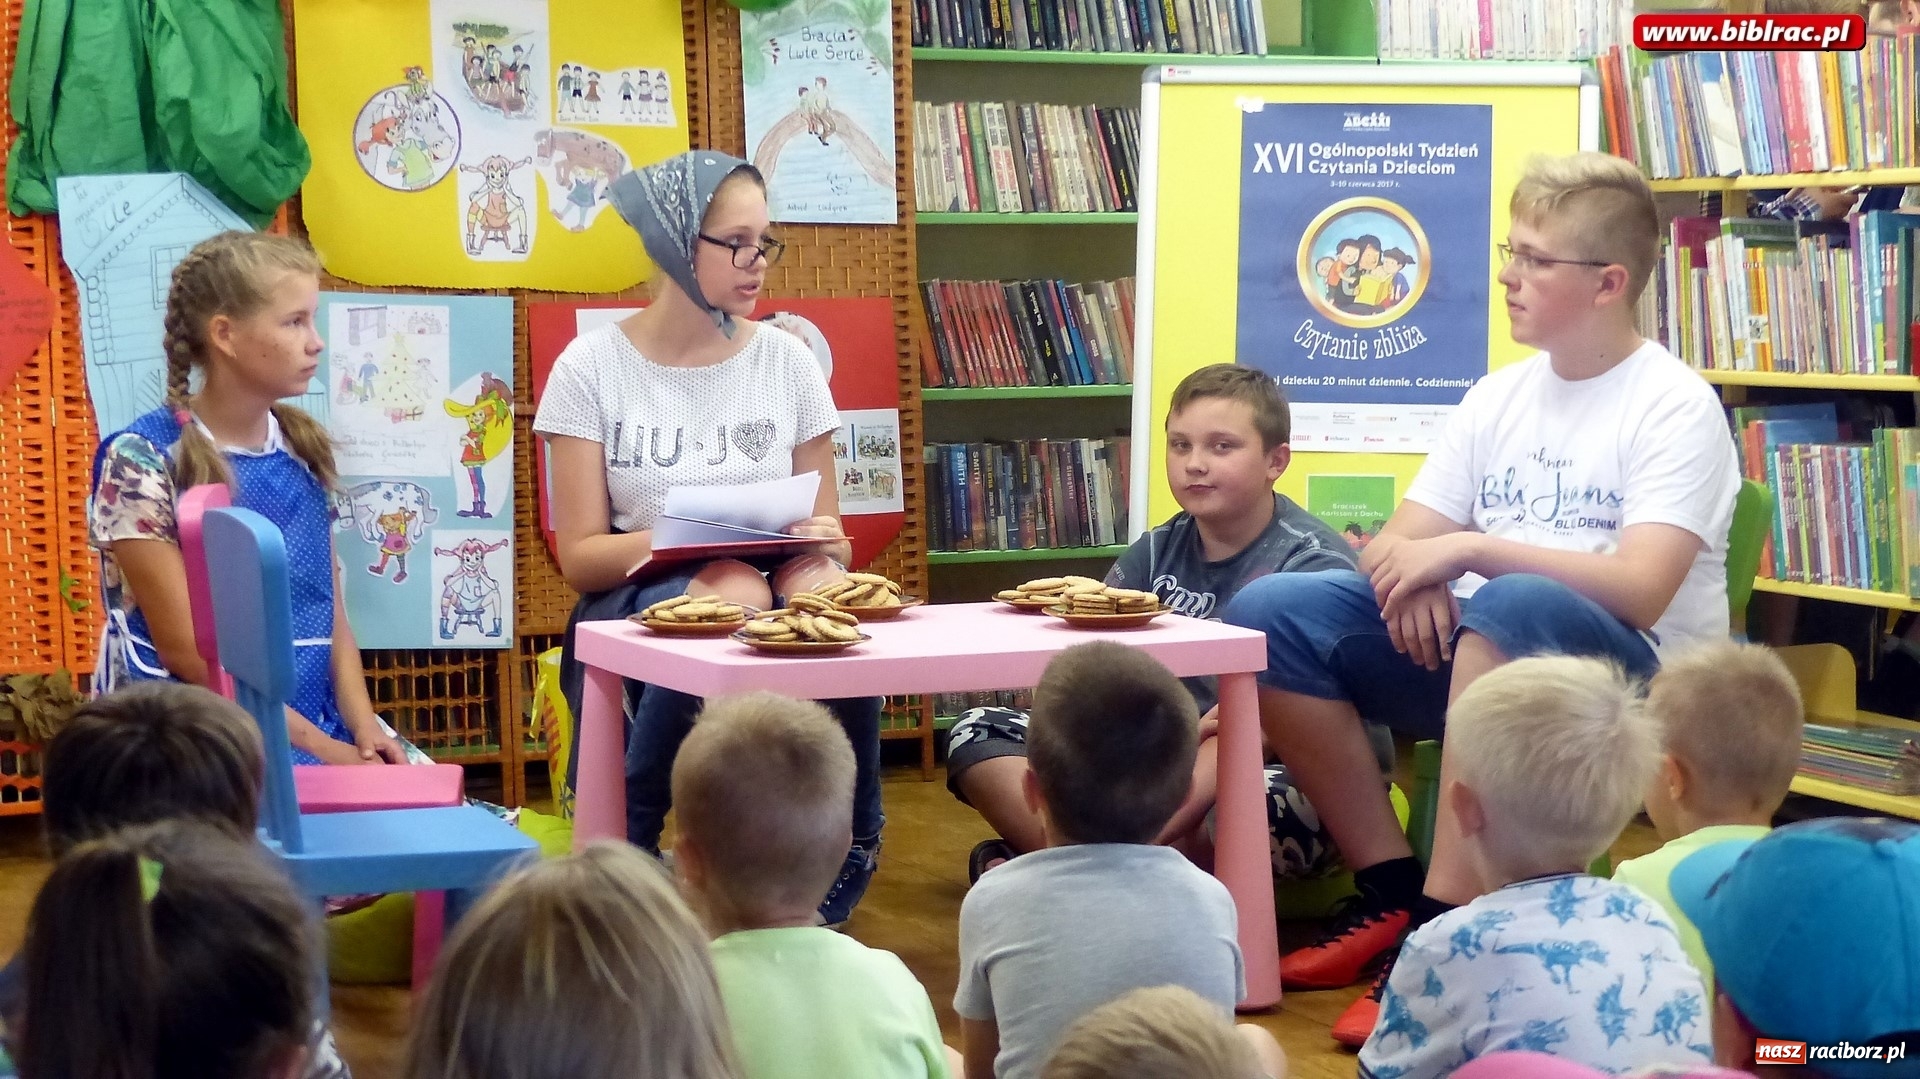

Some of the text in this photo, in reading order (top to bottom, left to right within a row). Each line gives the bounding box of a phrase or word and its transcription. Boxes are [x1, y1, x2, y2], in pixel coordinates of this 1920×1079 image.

[801, 26, 847, 42] Bracia
[824, 45, 865, 61] Serce
[1252, 142, 1304, 174] XVI
[1308, 142, 1479, 160] Ogólnopolski Tydzień
[1308, 160, 1456, 176] Czytania Dzieciom
[1376, 180, 1395, 188] 2017
[1293, 319, 1428, 361] Czytanie zbliża
[1282, 375, 1320, 386] dziecku
[1322, 376, 1336, 386] 20
[1338, 376, 1367, 387] minut
[1369, 376, 1413, 387] dziennie.
[1415, 377, 1474, 389] Codziennie!
[610, 421, 685, 468] LIU
[957, 451, 966, 486] SMITH
[972, 451, 981, 485] SMITH
[1577, 517, 1617, 531] DENIM
